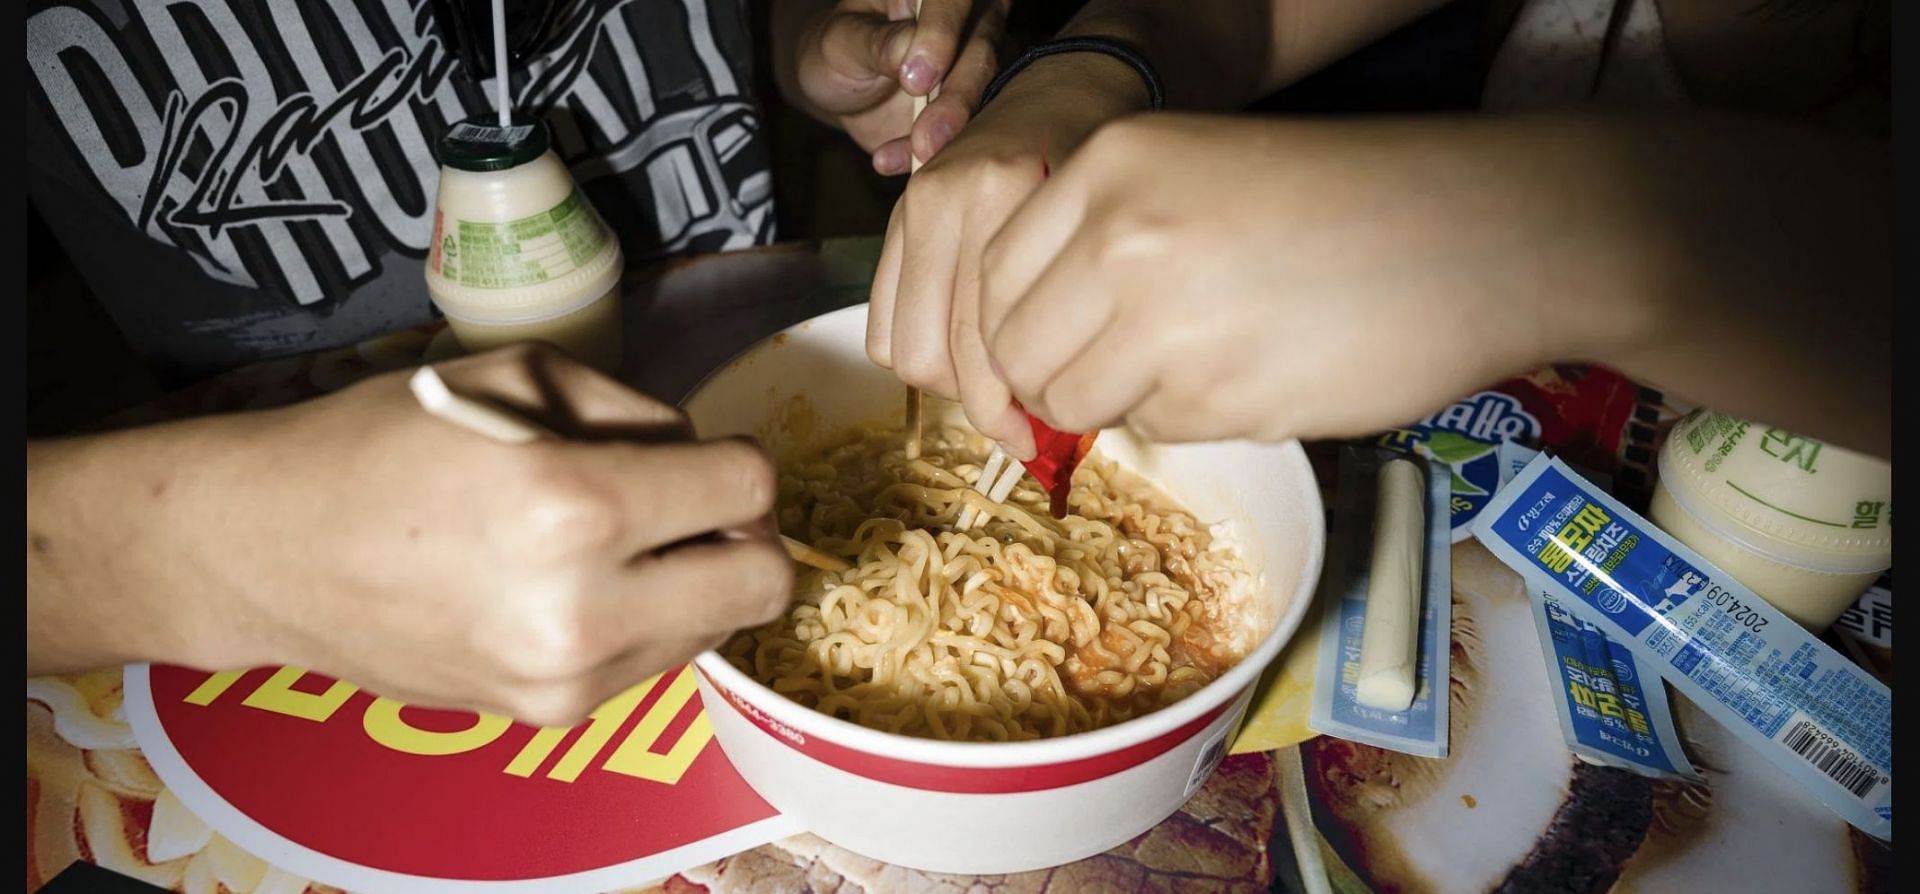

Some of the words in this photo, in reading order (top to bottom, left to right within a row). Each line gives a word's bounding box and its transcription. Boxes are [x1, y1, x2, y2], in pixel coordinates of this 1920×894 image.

[1719, 420, 1751, 456] 나나맛
[1526, 491, 1557, 520] 빙그레
[1537, 502, 1612, 575] 통모짜
